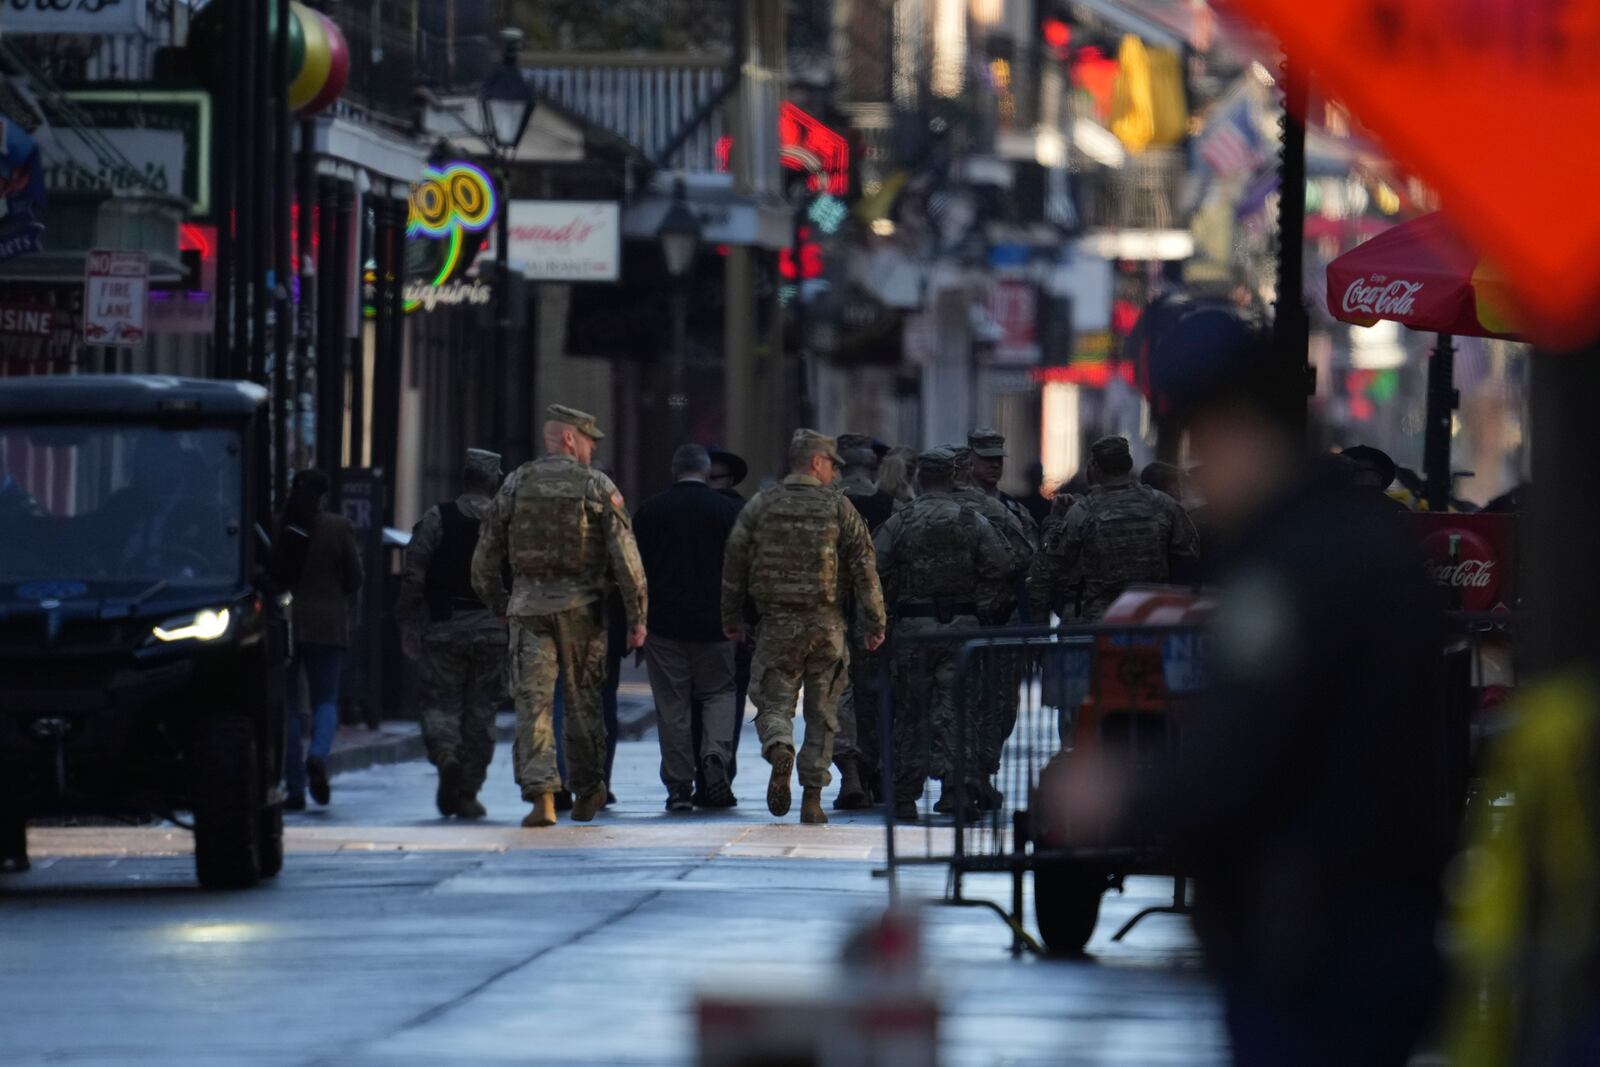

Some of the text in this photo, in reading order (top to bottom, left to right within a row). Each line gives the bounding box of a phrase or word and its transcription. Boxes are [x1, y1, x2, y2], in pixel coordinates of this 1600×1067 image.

[90, 253, 110, 273] NO
[100, 282, 131, 297] FIRE
[1342, 276, 1425, 315] Coca-Cola
[97, 302, 132, 319] LANE
[0, 308, 52, 334] SINE
